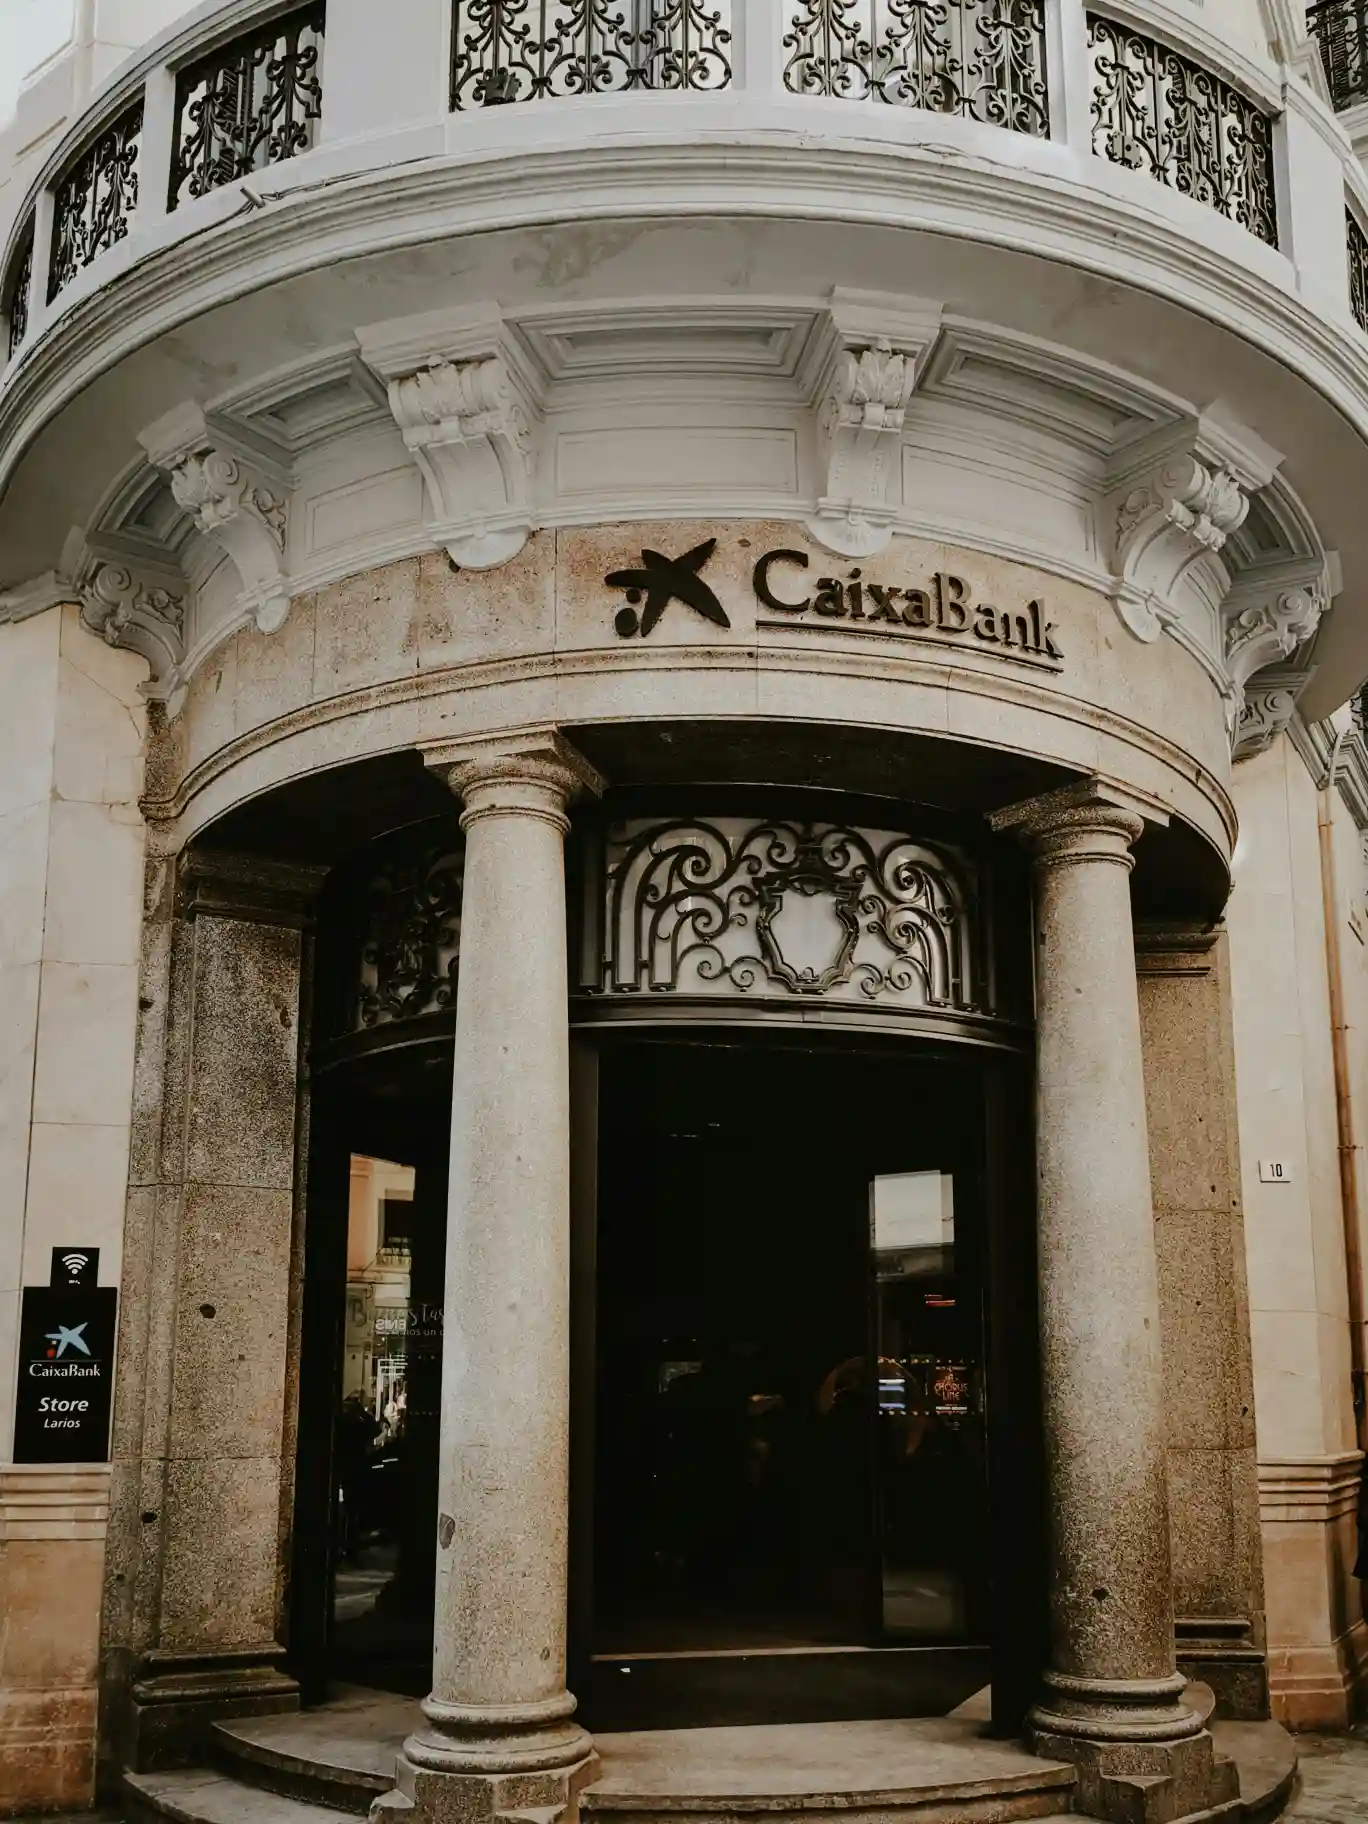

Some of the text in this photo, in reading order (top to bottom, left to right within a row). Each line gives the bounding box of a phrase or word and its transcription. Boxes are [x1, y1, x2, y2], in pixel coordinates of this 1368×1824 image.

[752, 548, 1065, 659] CaixaBank
[1270, 1163, 1283, 1178] 10
[29, 1363, 101, 1377] CaixaBank
[38, 1396, 90, 1413] Store
[43, 1415, 82, 1429] Larios
